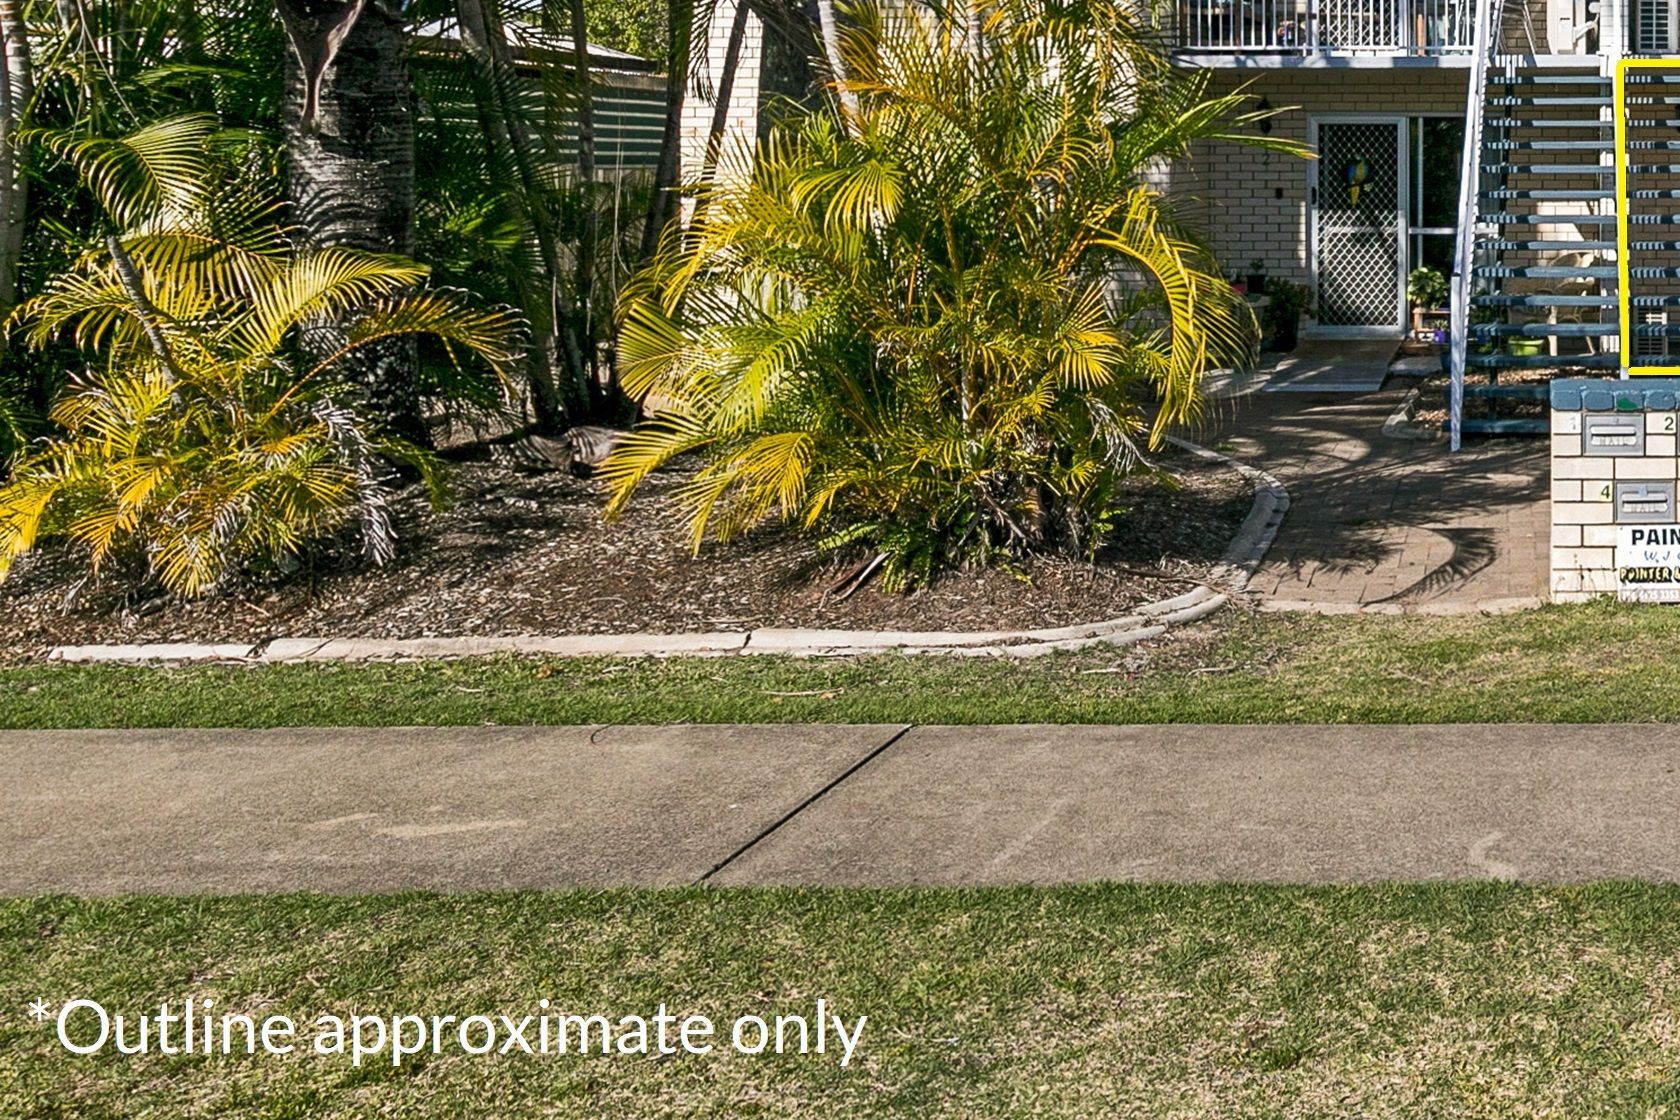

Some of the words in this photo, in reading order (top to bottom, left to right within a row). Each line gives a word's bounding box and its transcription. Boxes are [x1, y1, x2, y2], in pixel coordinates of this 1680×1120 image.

[1664, 416, 1674, 431] 2
[1600, 485, 1611, 499] 4
[1620, 566, 1671, 581] PAINTER
